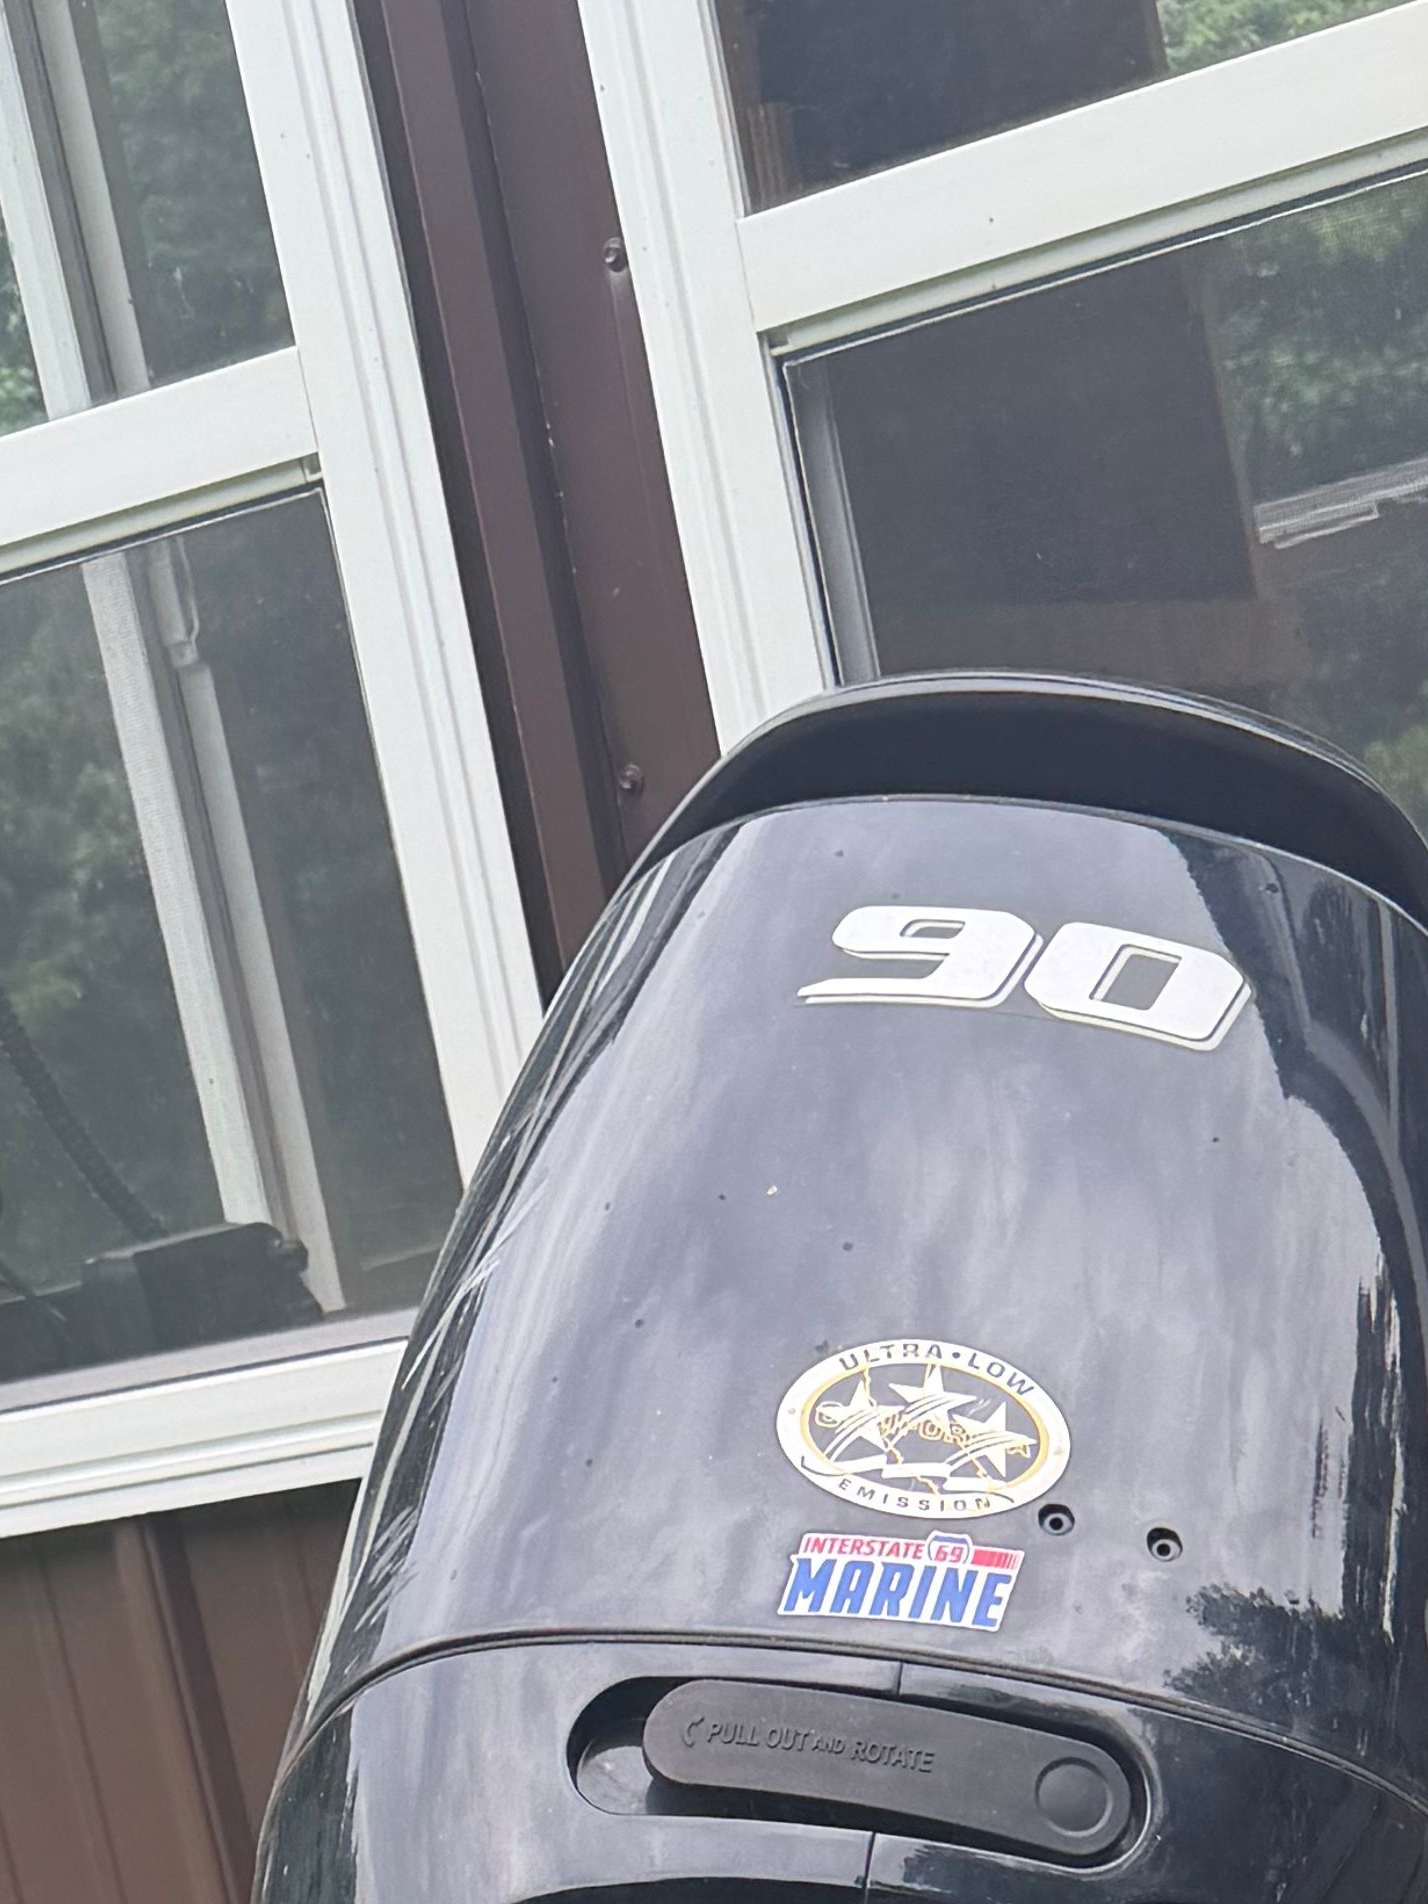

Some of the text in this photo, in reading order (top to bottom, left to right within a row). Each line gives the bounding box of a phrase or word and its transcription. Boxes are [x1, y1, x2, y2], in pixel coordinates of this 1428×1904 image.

[796, 905, 1253, 1053] 90
[837, 1478, 992, 1511] EMISSION
[802, 1536, 964, 1563] INTERSTATE 69
[783, 1557, 1012, 1628] MARINE
[707, 1723, 936, 1774] PULL OUT AND ROTATE
